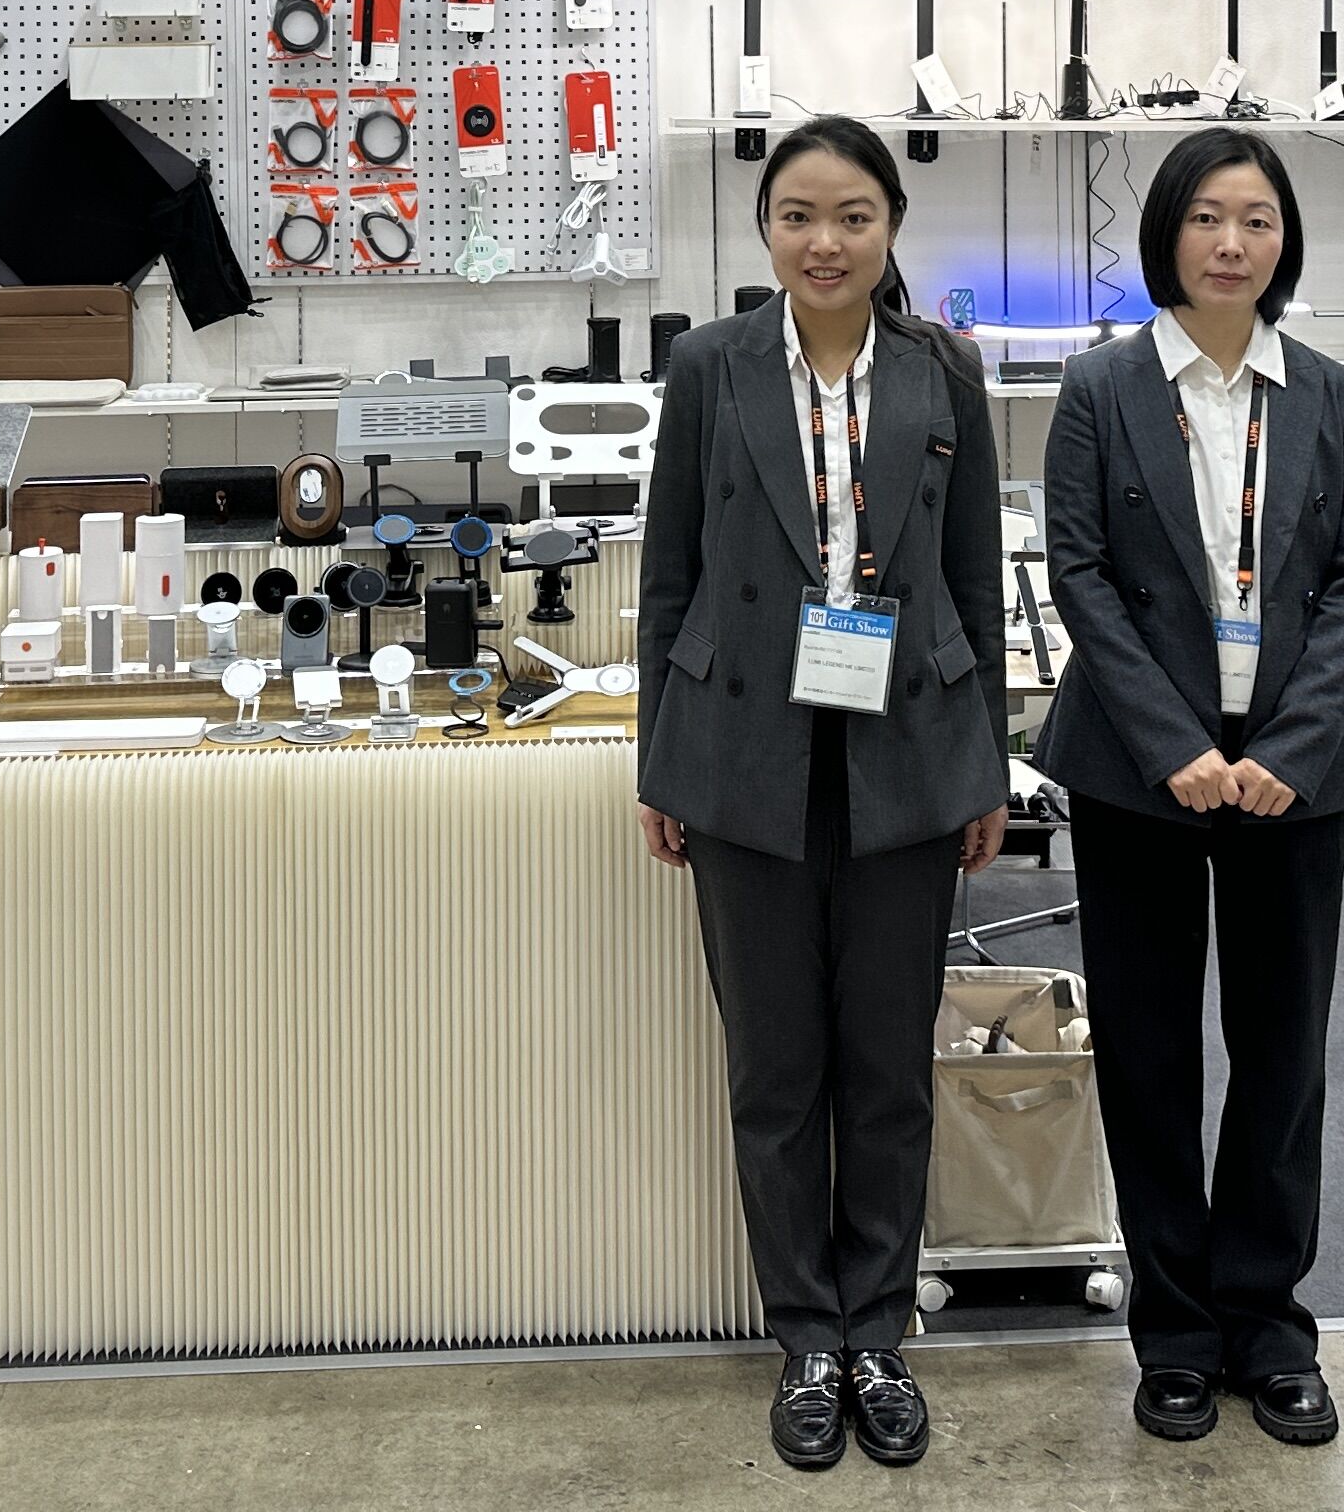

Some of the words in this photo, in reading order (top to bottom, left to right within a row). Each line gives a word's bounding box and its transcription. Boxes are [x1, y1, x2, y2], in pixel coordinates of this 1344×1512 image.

[813, 407, 823, 435] LUMI
[848, 415, 860, 443] LUMI
[1247, 420, 1261, 449] LUMI
[816, 474, 826, 504] LUMI
[853, 482, 866, 512] LUMI
[1243, 487, 1255, 517] LUMI
[810, 611, 824, 623] 101
[827, 616, 854, 631] Gift
[856, 620, 889, 635] Show
[1225, 628, 1258, 643] Show
